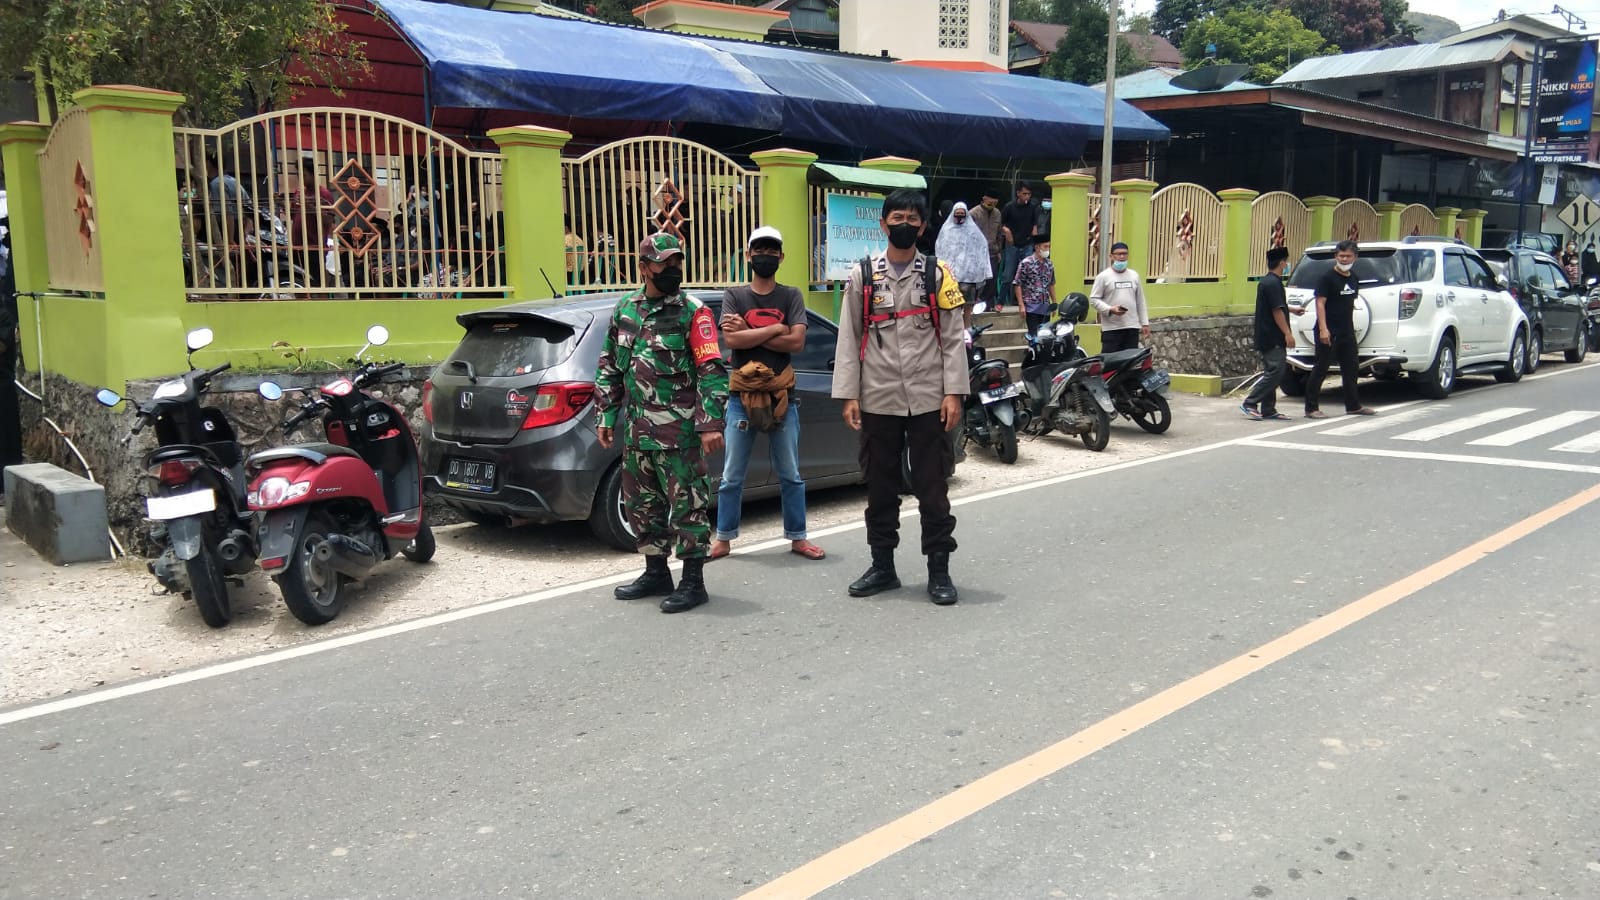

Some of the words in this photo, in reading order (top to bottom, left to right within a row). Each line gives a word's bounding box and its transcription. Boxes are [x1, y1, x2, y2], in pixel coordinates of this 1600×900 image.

[1541, 83, 1569, 92] NIKKI
[1570, 82, 1594, 91] NIKKI
[1553, 155, 1582, 164] FATHUR
